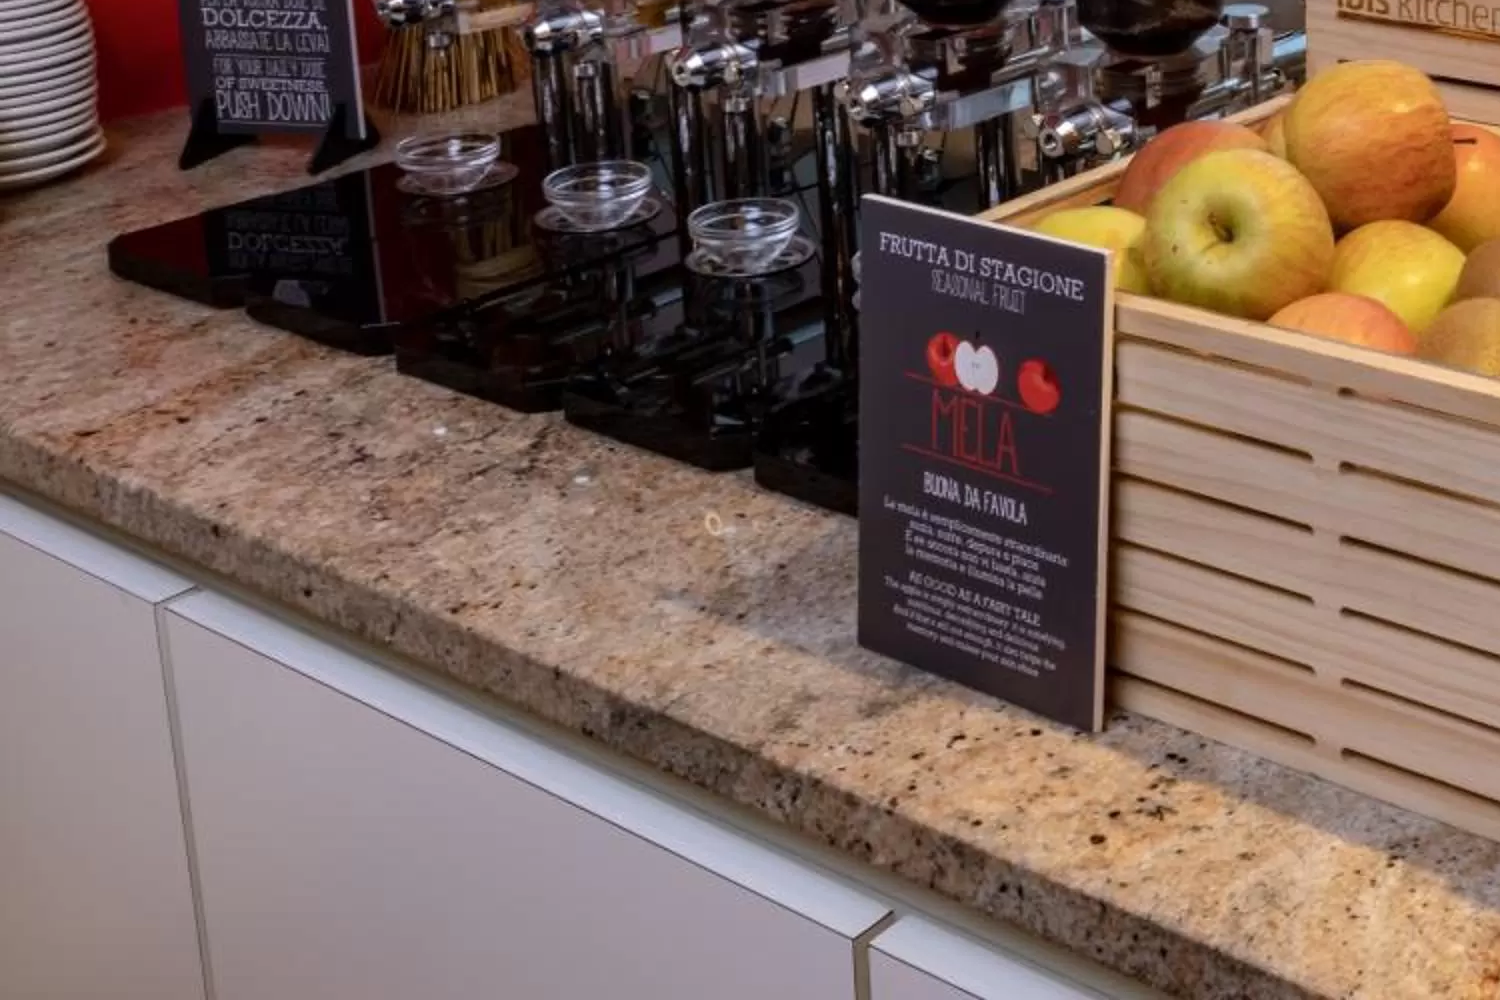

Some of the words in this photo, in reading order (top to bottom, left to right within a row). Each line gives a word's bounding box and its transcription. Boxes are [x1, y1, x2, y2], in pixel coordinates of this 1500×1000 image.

[200, 7, 328, 31] DOLCEZZA,
[215, 89, 260, 119] PUSH
[267, 90, 331, 121] DOWN!
[879, 231, 950, 267] FRUTTA
[954, 250, 975, 273] DI
[979, 257, 1085, 301] STAGIONE
[931, 387, 1021, 476] MELA
